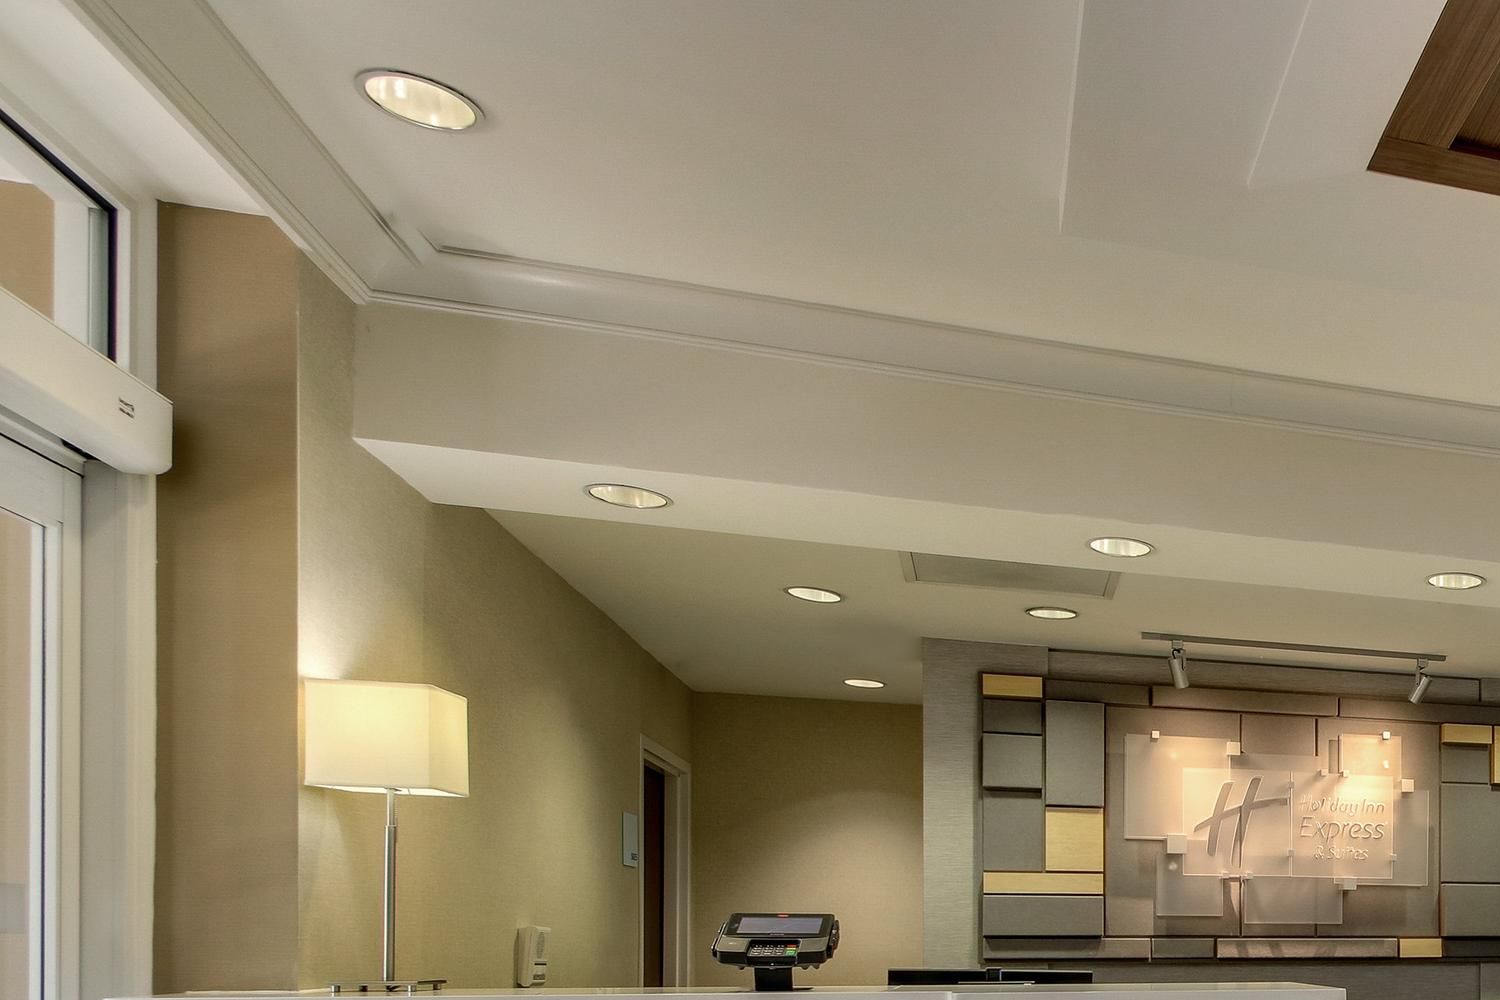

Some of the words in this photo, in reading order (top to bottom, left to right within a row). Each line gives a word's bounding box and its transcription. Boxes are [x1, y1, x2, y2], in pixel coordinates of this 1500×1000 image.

[1298, 795, 1359, 817] Holiday
[1361, 798, 1385, 814] Inn
[1299, 815, 1385, 844] Express
